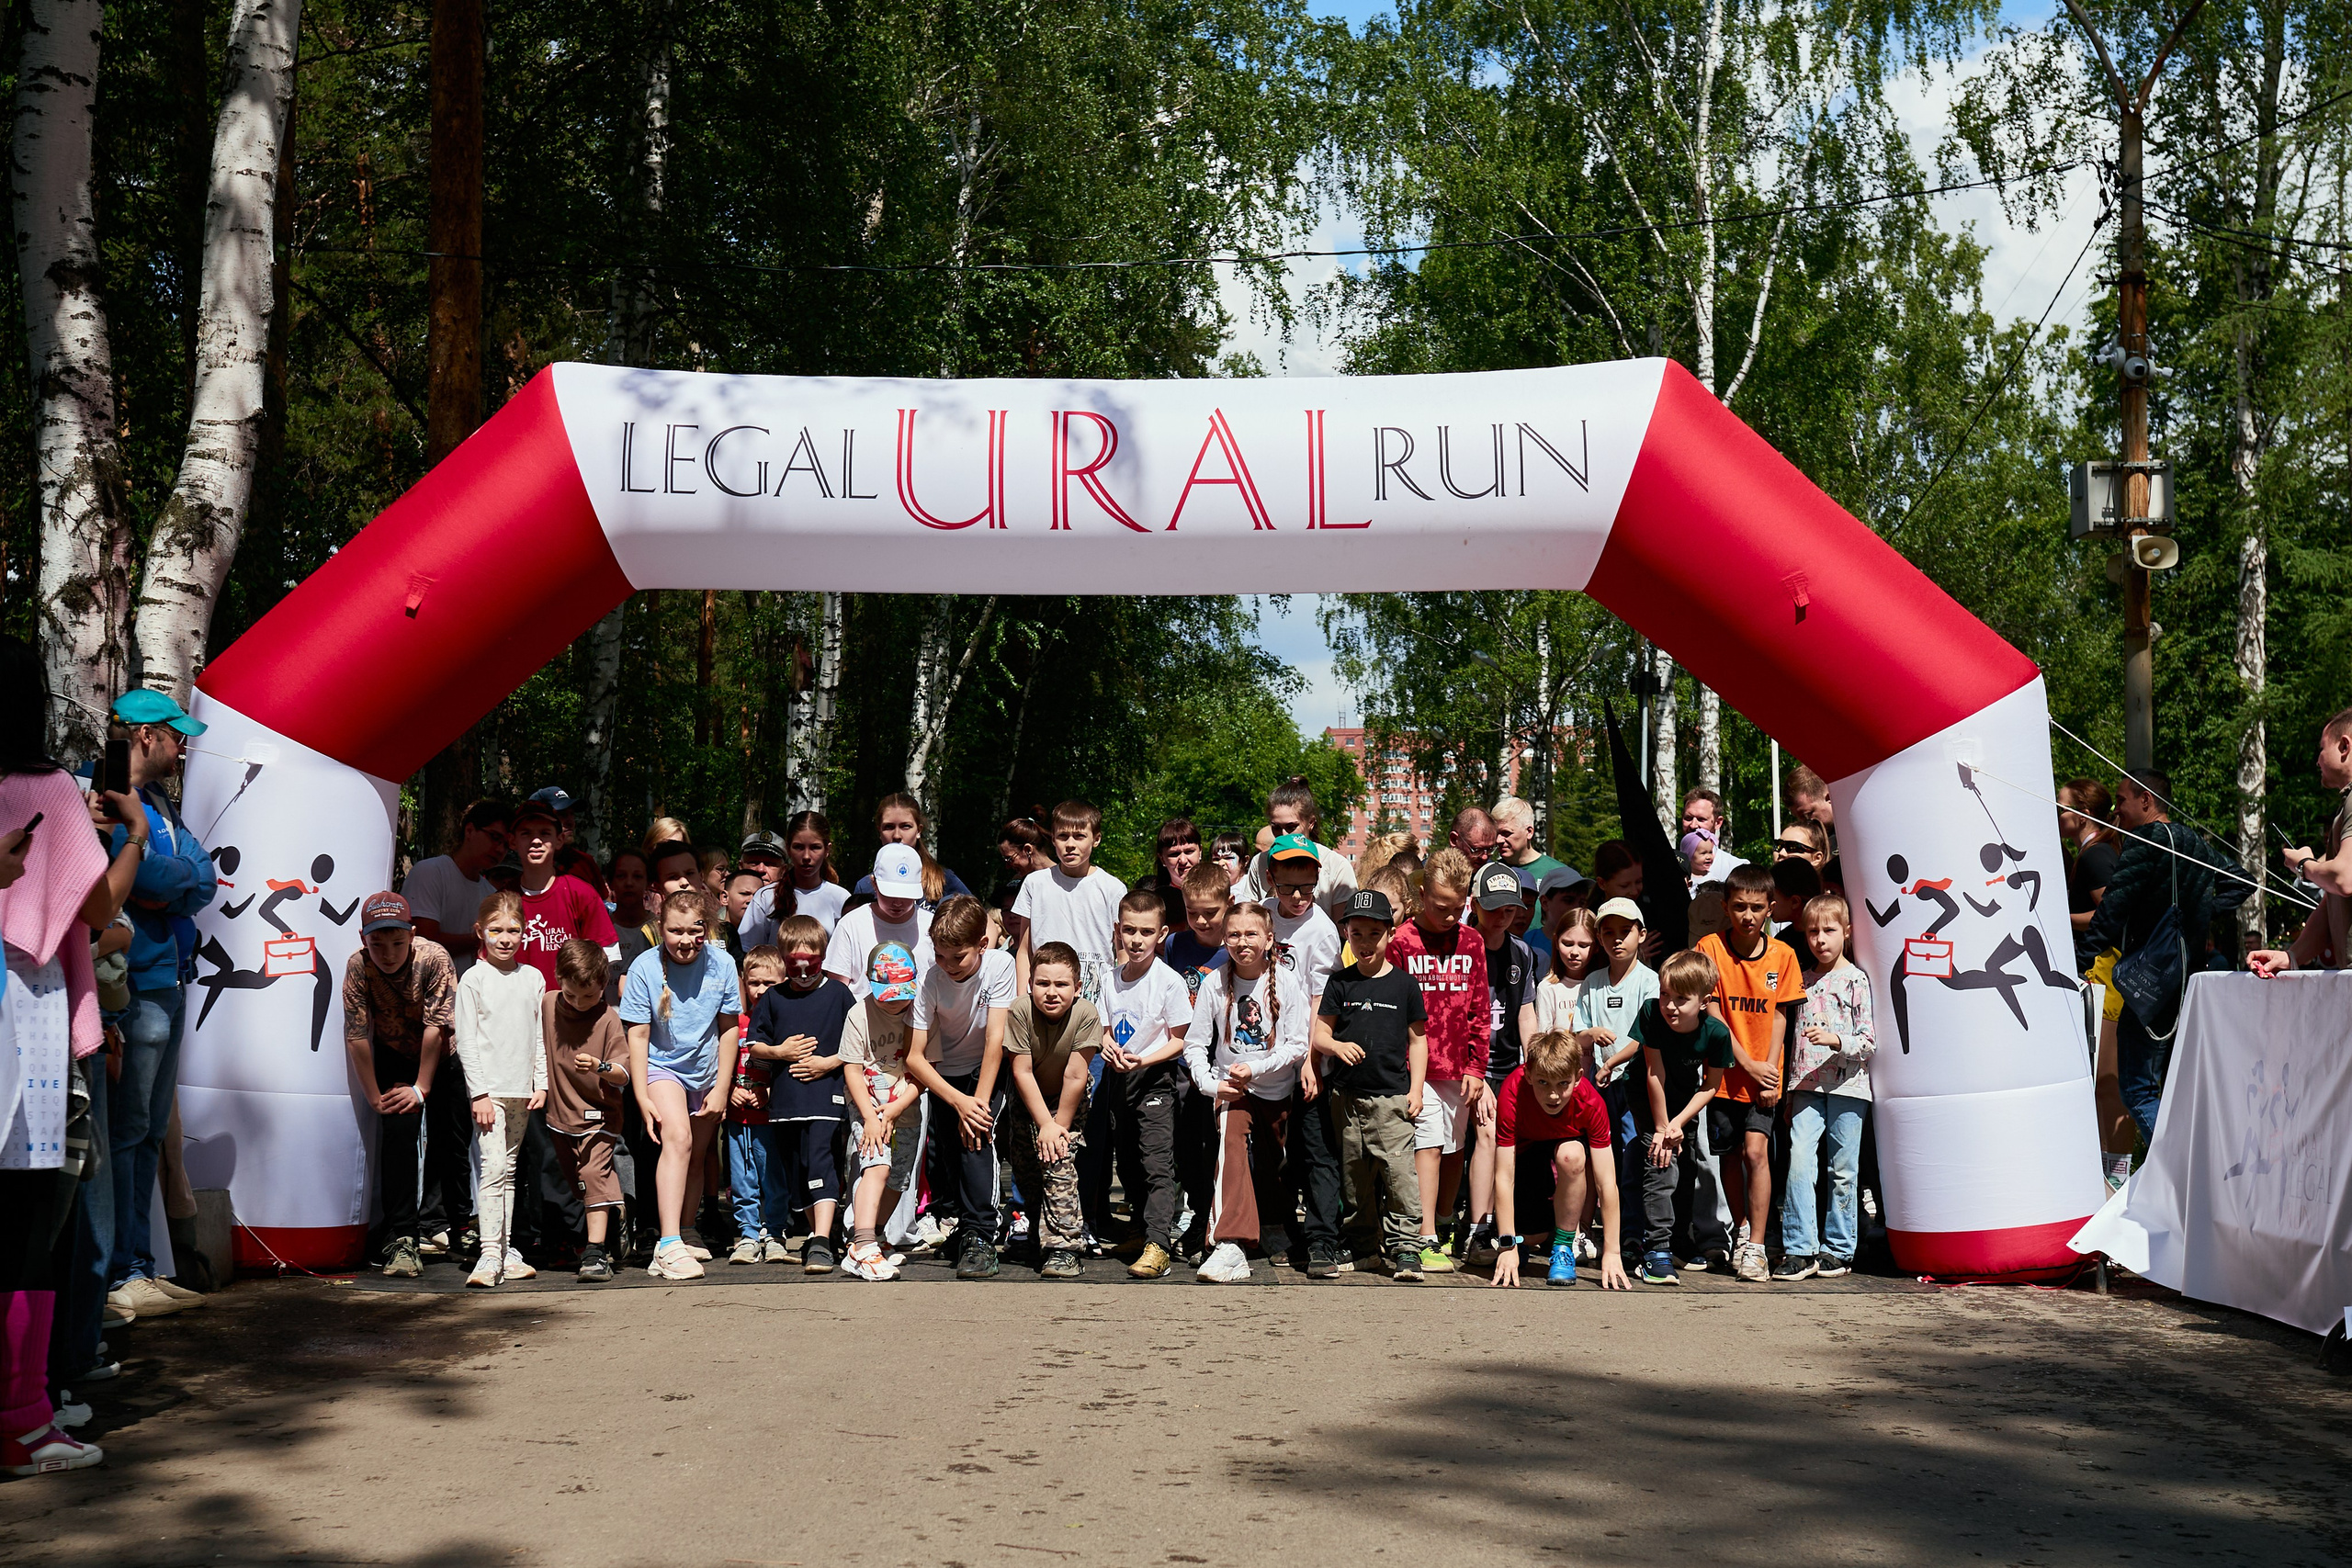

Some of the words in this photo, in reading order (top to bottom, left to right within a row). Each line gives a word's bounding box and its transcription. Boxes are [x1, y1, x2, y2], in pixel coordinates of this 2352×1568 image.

[620, 422, 878, 500] LEGAL
[897, 408, 1372, 531] URAL
[1373, 419, 1589, 501] RUN
[1354, 891, 1373, 908] 18
[546, 927, 566, 935] URAL
[1728, 996, 1769, 1013] TMK
